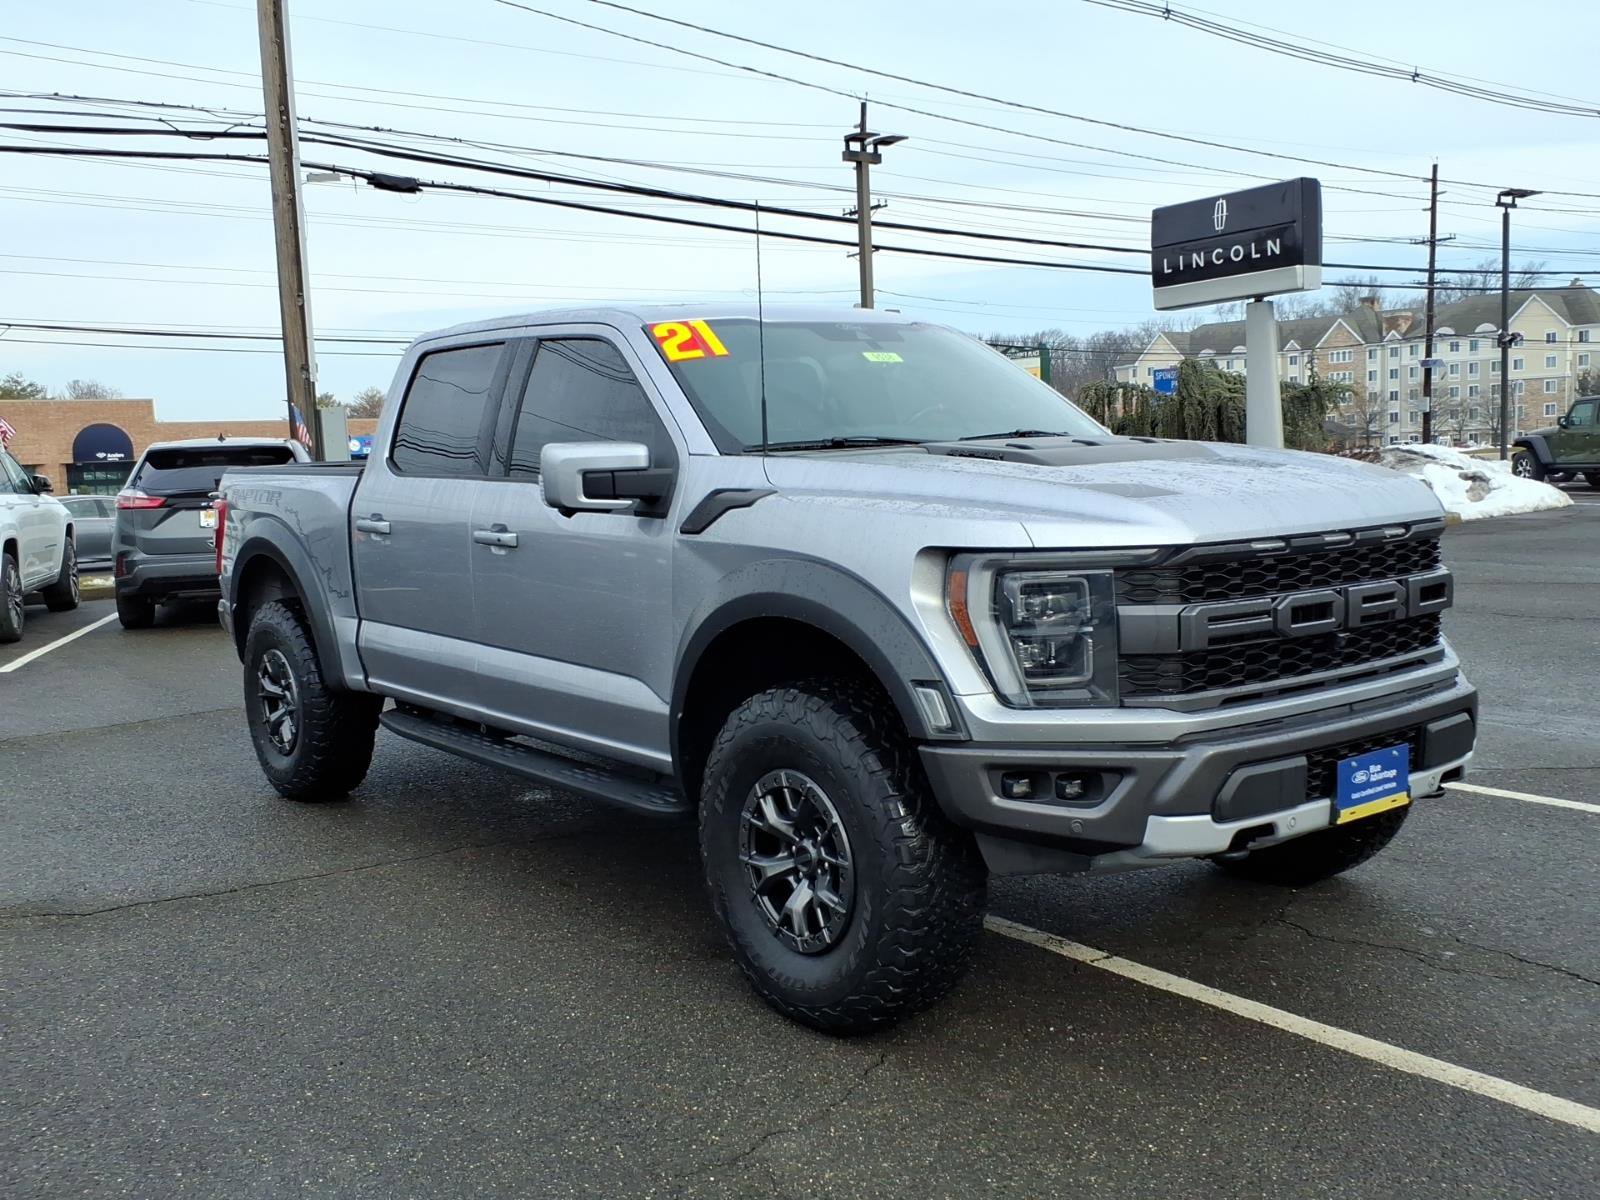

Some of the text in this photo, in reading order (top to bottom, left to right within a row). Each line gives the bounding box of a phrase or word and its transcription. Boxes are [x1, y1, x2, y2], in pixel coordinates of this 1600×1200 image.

[1163, 238, 1280, 274] LINCOLN
[652, 319, 729, 361] 21
[232, 487, 283, 508] RAPTOR
[1180, 570, 1454, 654] FORD
